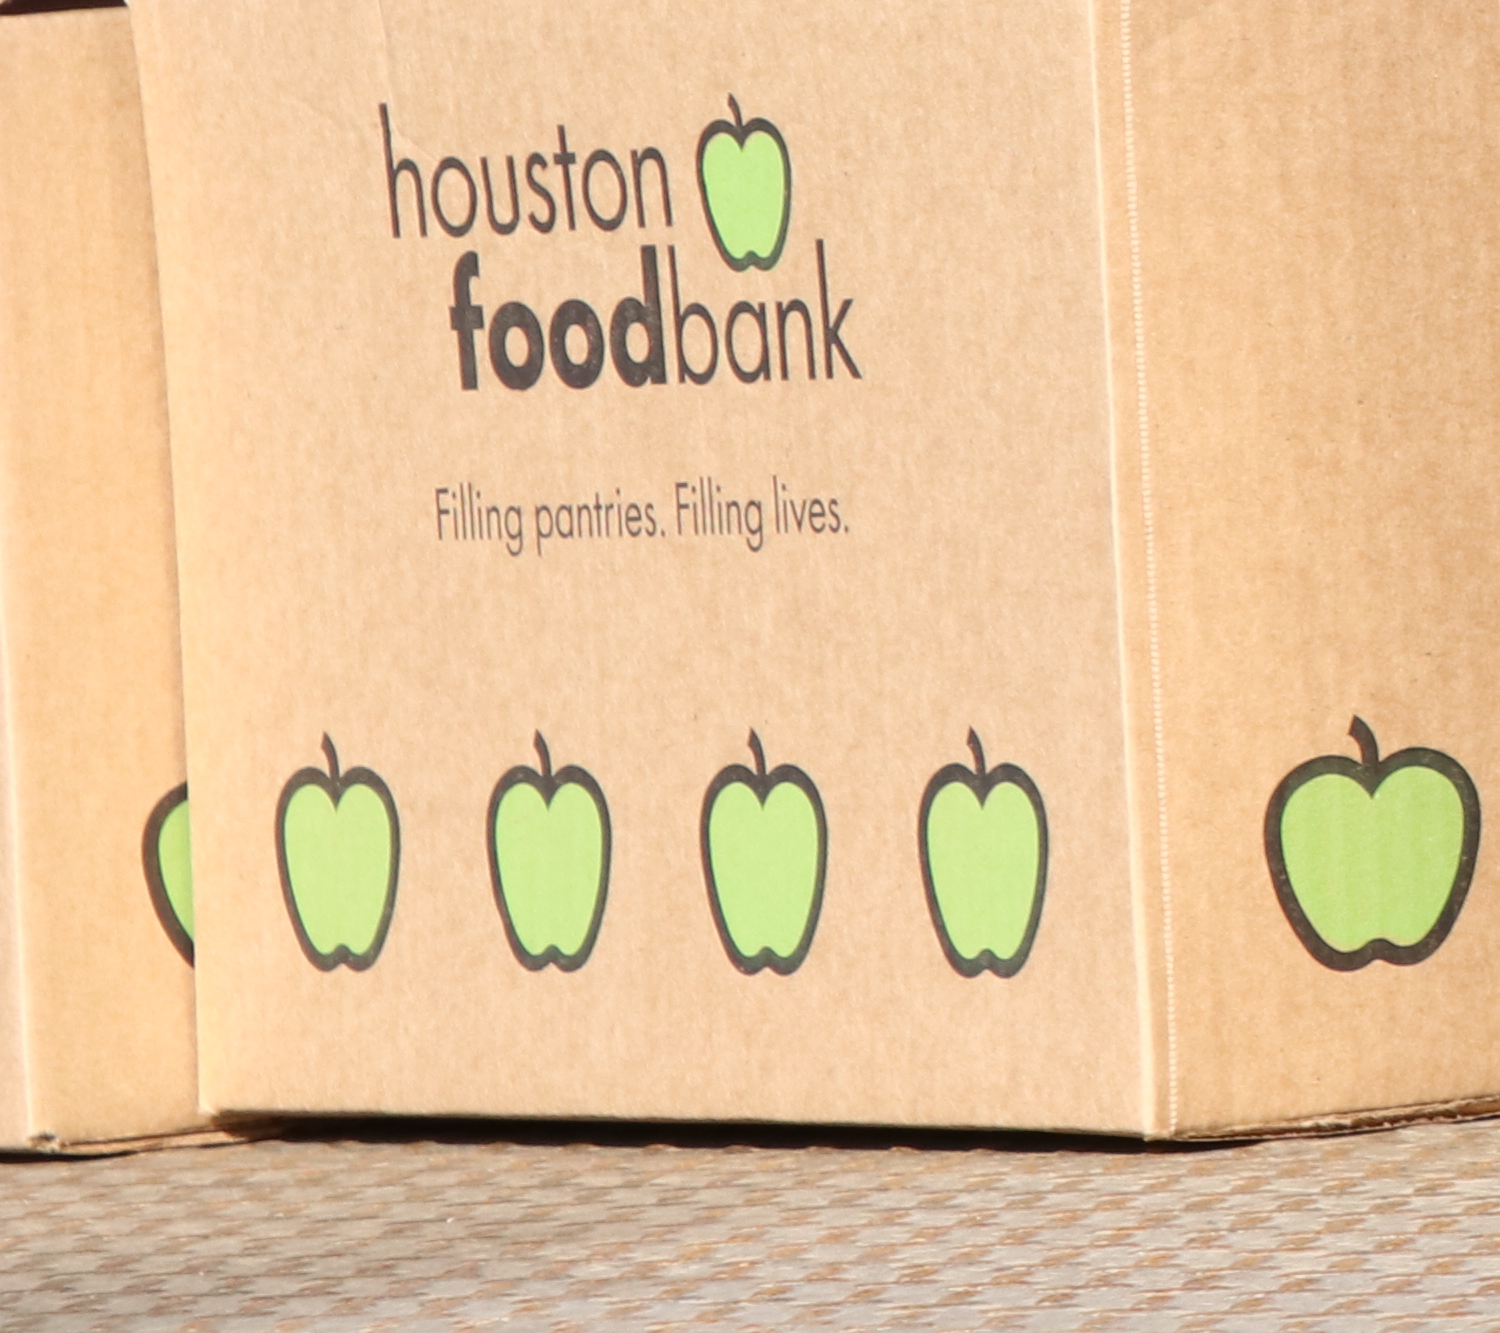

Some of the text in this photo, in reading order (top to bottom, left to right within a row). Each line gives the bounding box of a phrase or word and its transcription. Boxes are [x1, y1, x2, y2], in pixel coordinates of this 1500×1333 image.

[378, 102, 674, 239] houston
[449, 238, 863, 392] foodbank
[434, 475, 850, 558] Filling pantries. Filling lives.
